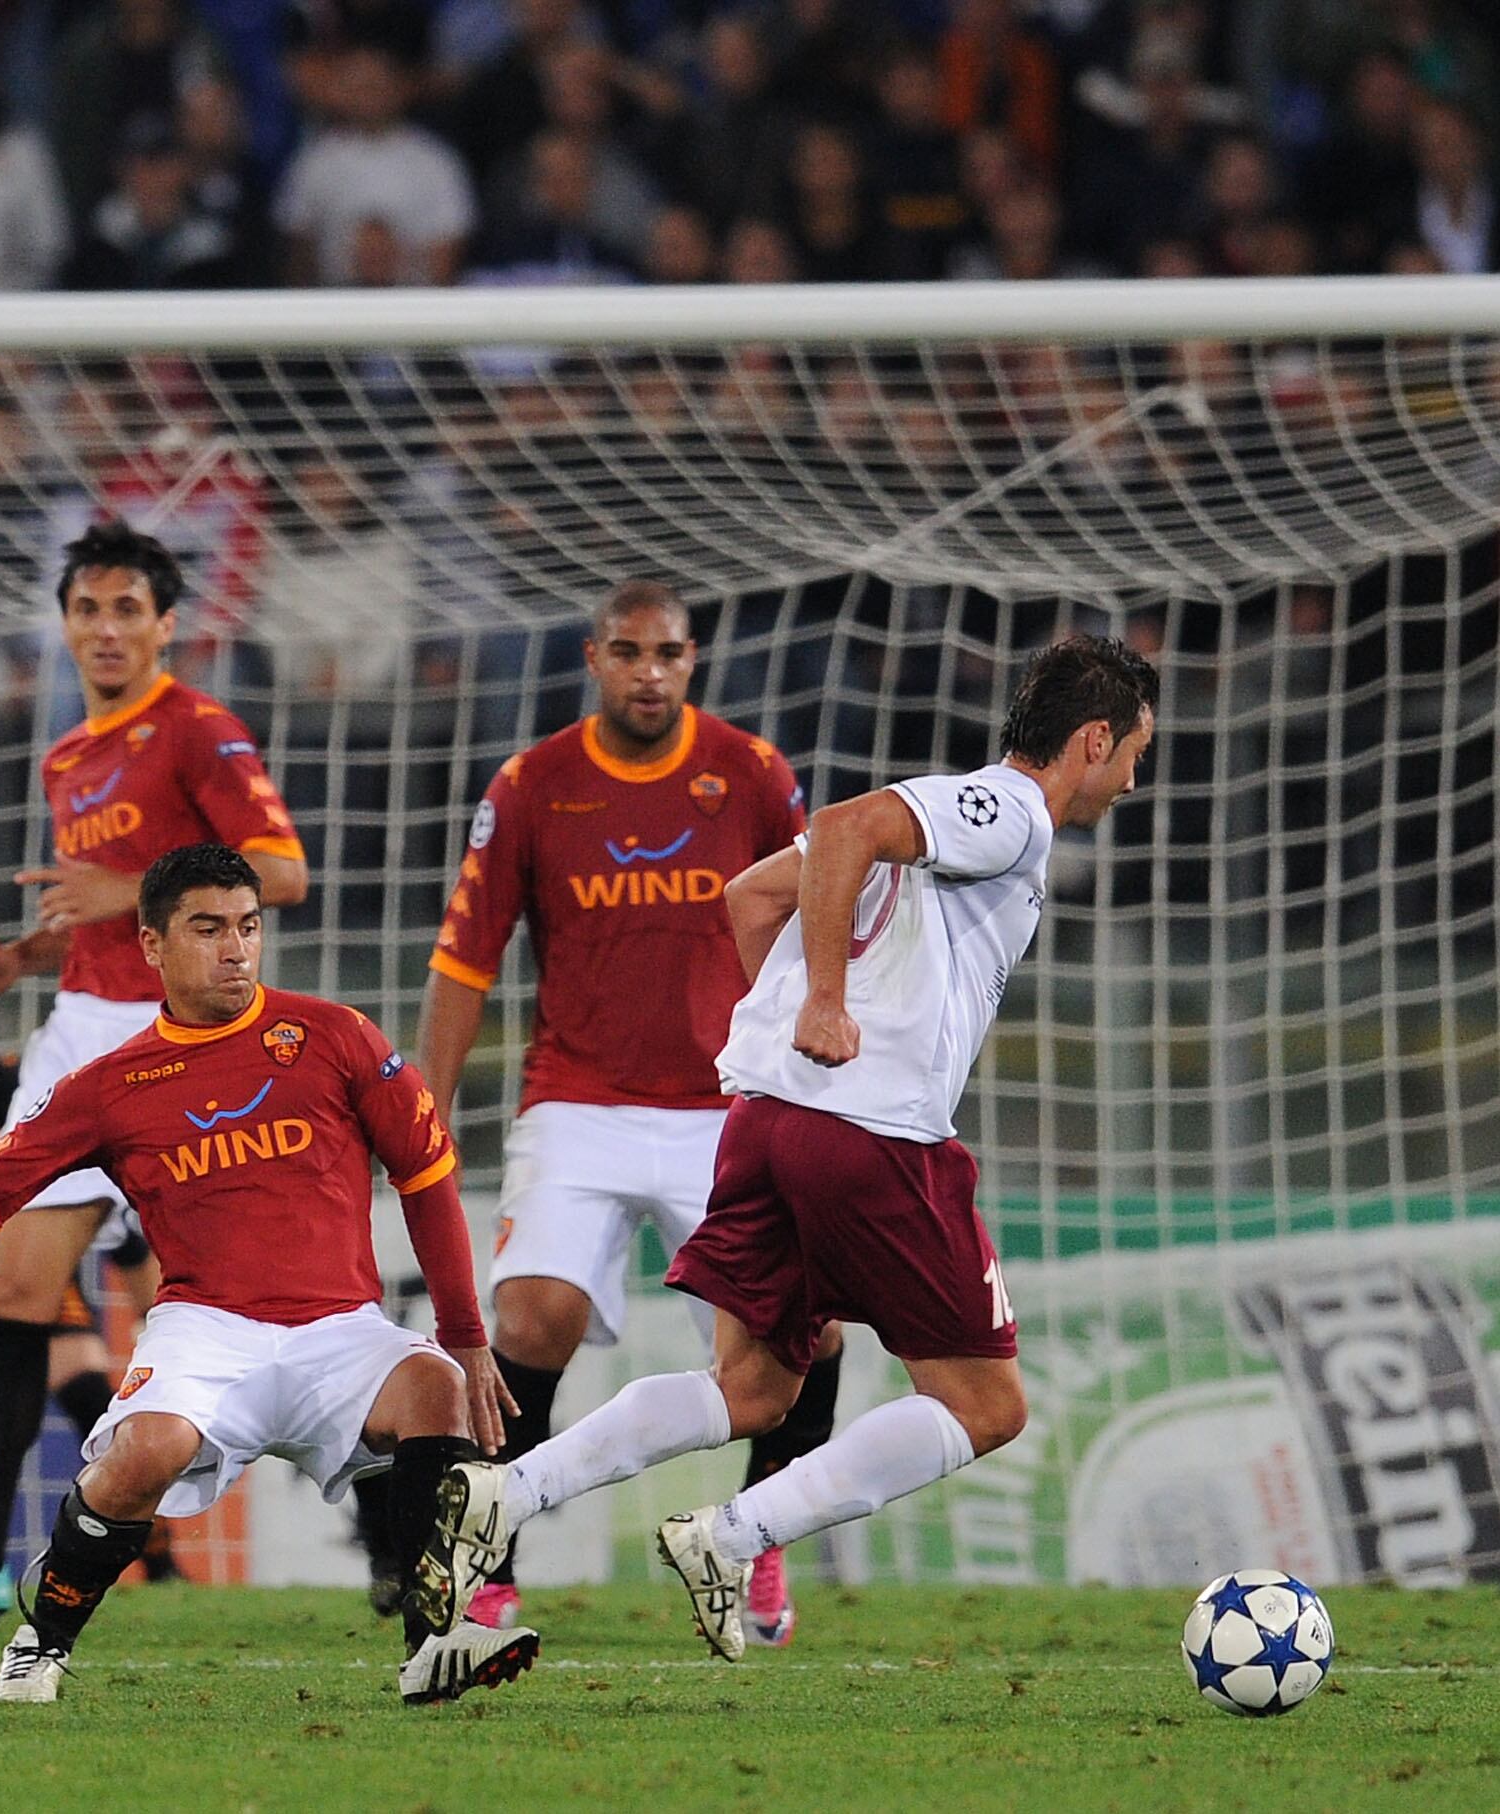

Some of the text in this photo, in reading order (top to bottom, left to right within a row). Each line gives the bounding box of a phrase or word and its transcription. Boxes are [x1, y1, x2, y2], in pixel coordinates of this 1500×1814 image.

[568, 868, 725, 910] WIND
[124, 1061, 186, 1084] Kappa
[159, 1118, 313, 1183] WIND
